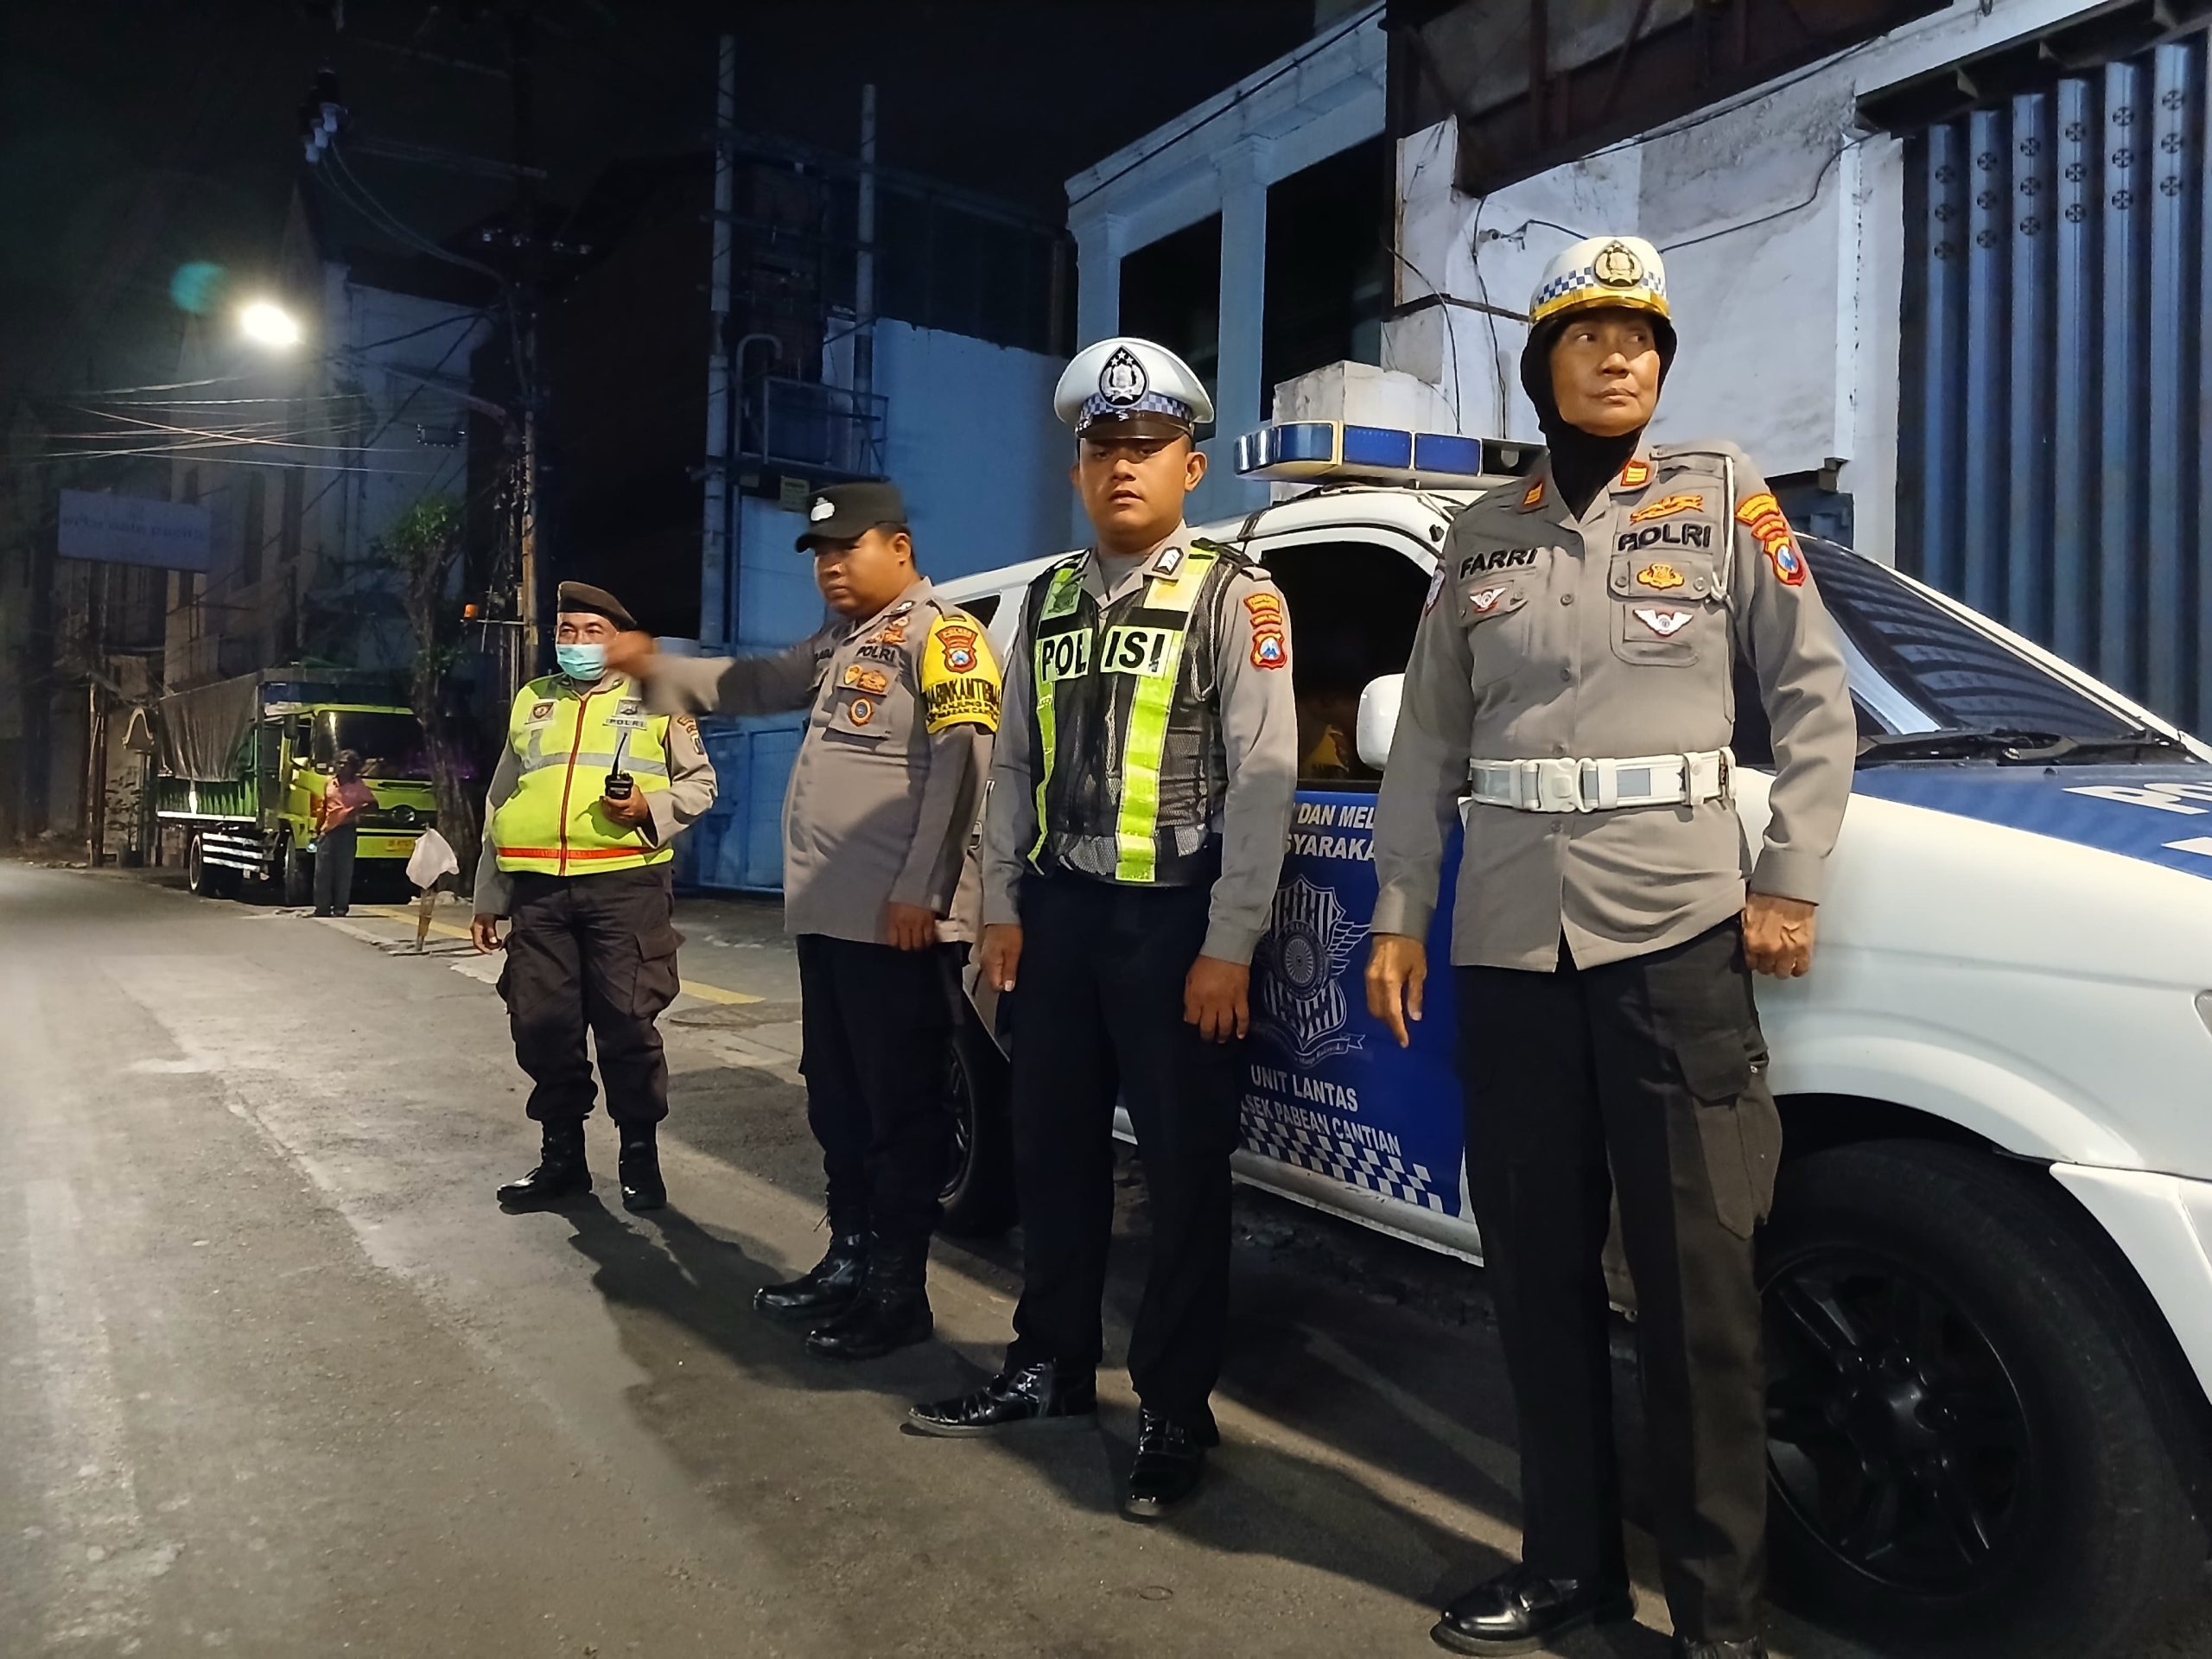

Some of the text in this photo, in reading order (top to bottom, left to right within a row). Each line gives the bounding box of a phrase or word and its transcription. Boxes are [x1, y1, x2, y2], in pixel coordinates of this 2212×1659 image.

[1618, 523, 1711, 551] POLRI
[1459, 549, 1538, 580] FARRI
[855, 645, 897, 663] POLRI
[609, 719, 645, 728] POLRI
[1297, 803, 1337, 826] DAN
[1250, 1064, 1358, 1112] UNIT LANTAS
[1274, 1101, 1331, 1136] PABEAN
[1332, 1116, 1402, 1156] CANTIAN
